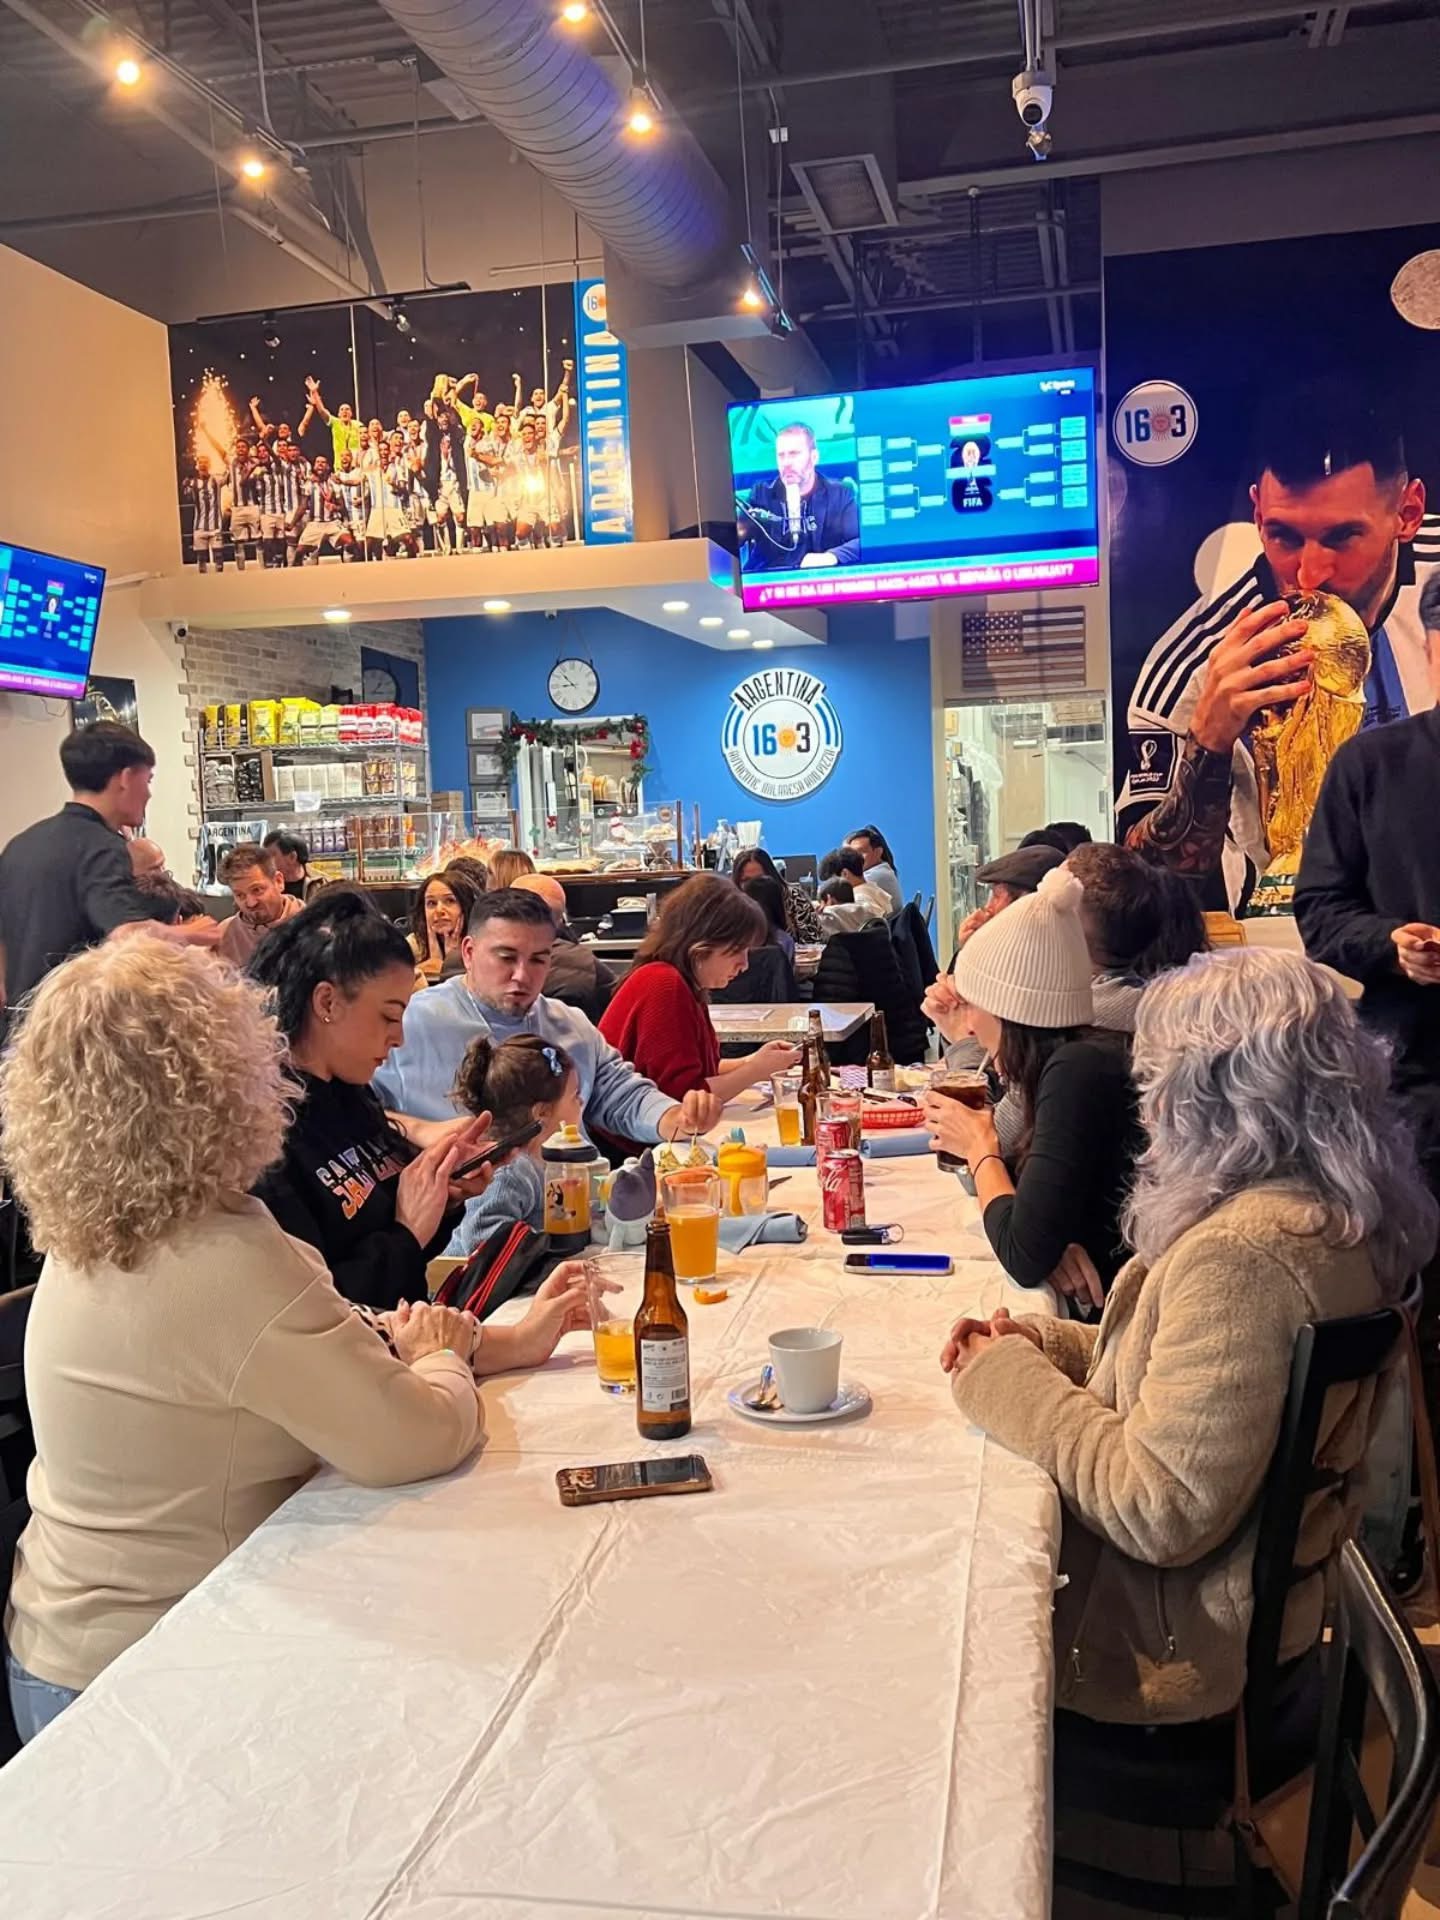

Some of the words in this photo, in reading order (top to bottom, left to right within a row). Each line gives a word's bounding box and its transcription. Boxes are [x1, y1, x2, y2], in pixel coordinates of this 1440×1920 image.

[584, 330, 627, 534] ARGENTINA
[1125, 408, 1151, 443] 16
[963, 497, 983, 508] FIFA
[734, 671, 821, 711] ARGENTINA
[753, 723, 777, 756] 16
[207, 826, 252, 838] ARGENTINA
